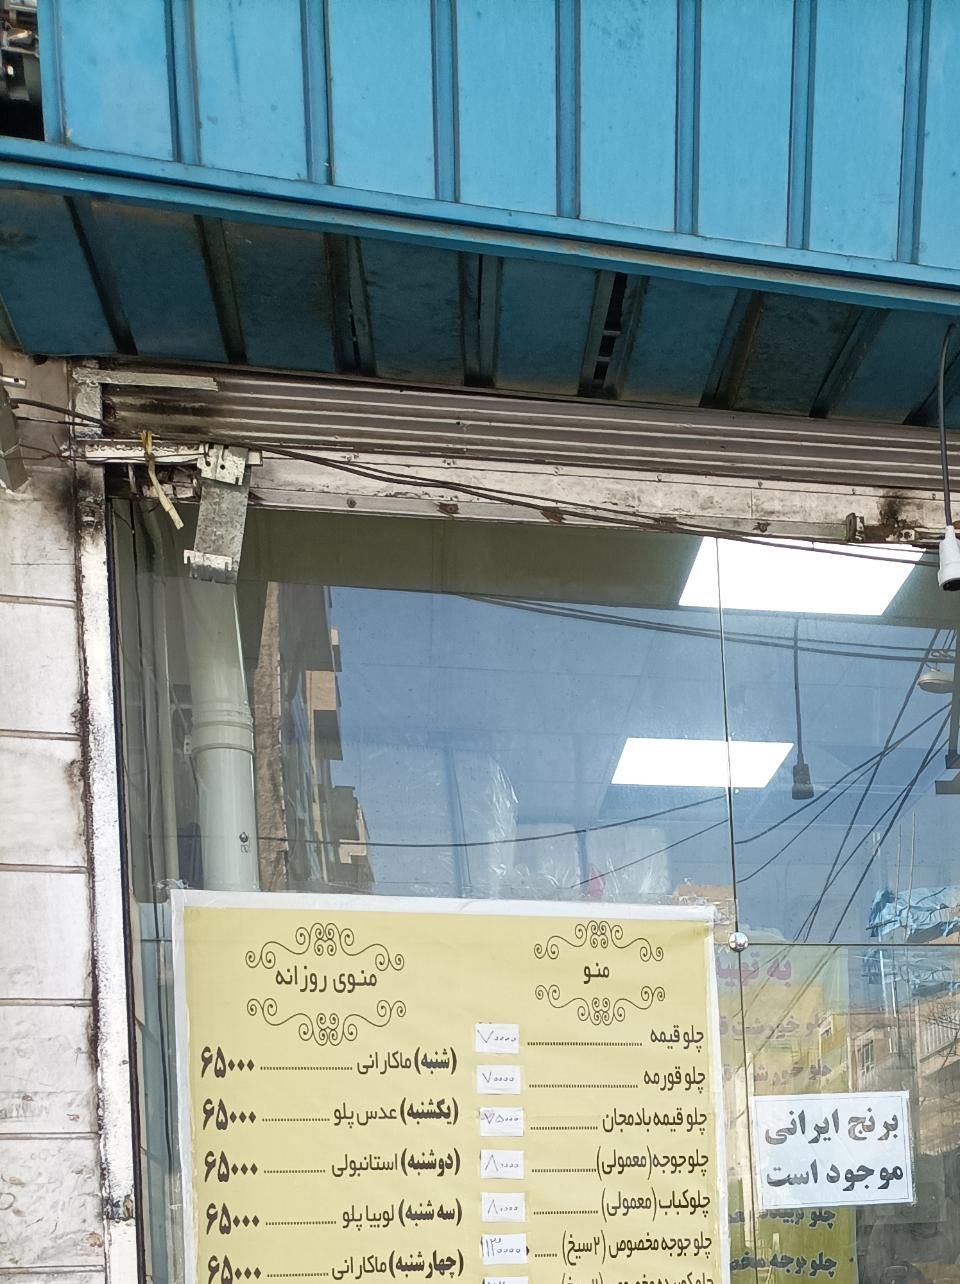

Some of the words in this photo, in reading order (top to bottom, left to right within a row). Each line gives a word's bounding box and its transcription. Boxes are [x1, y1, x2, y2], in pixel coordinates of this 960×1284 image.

[275, 965, 328, 993] روزانه
[332, 969, 378, 993] منوی
[583, 961, 610, 984] منو
[650, 1024, 681, 1050] قیمه
[682, 1024, 704, 1053] چلو
[200, 1046, 255, 1079] ۶۵۰۰۰
[356, 1050, 412, 1075] ماکارانی
[414, 1046, 457, 1075] (شنبه)
[643, 1066, 683, 1092] قورمه
[684, 1066, 706, 1095] چلو
[202, 1097, 257, 1131] ۶۵۰۰۰
[333, 1102, 356, 1130] پلو
[356, 1104, 397, 1127] عدس
[400, 1096, 460, 1126] (یکشنبه)
[602, 1106, 652, 1134] بادمجان
[652, 1106, 684, 1133] قیمه
[686, 1106, 708, 1135] چلو
[848, 1107, 899, 1142] برنج
[764, 1107, 840, 1145] ایرانی
[203, 1150, 259, 1184] ۶۵۰۰۰
[331, 1152, 399, 1178] استانبولی
[400, 1147, 461, 1178] (دوشنبه)
[766, 1159, 818, 1188] است
[826, 1162, 904, 1192] موجود
[205, 1202, 260, 1236] ۶۵۰۰۰
[341, 1205, 363, 1232] پلو
[364, 1203, 395, 1229] لوبیا
[607, 1231, 659, 1259] مخصوص
[660, 1236, 691, 1258] جوجه
[693, 1231, 713, 1260] چلو
[331, 1254, 387, 1281] ماکارانی
